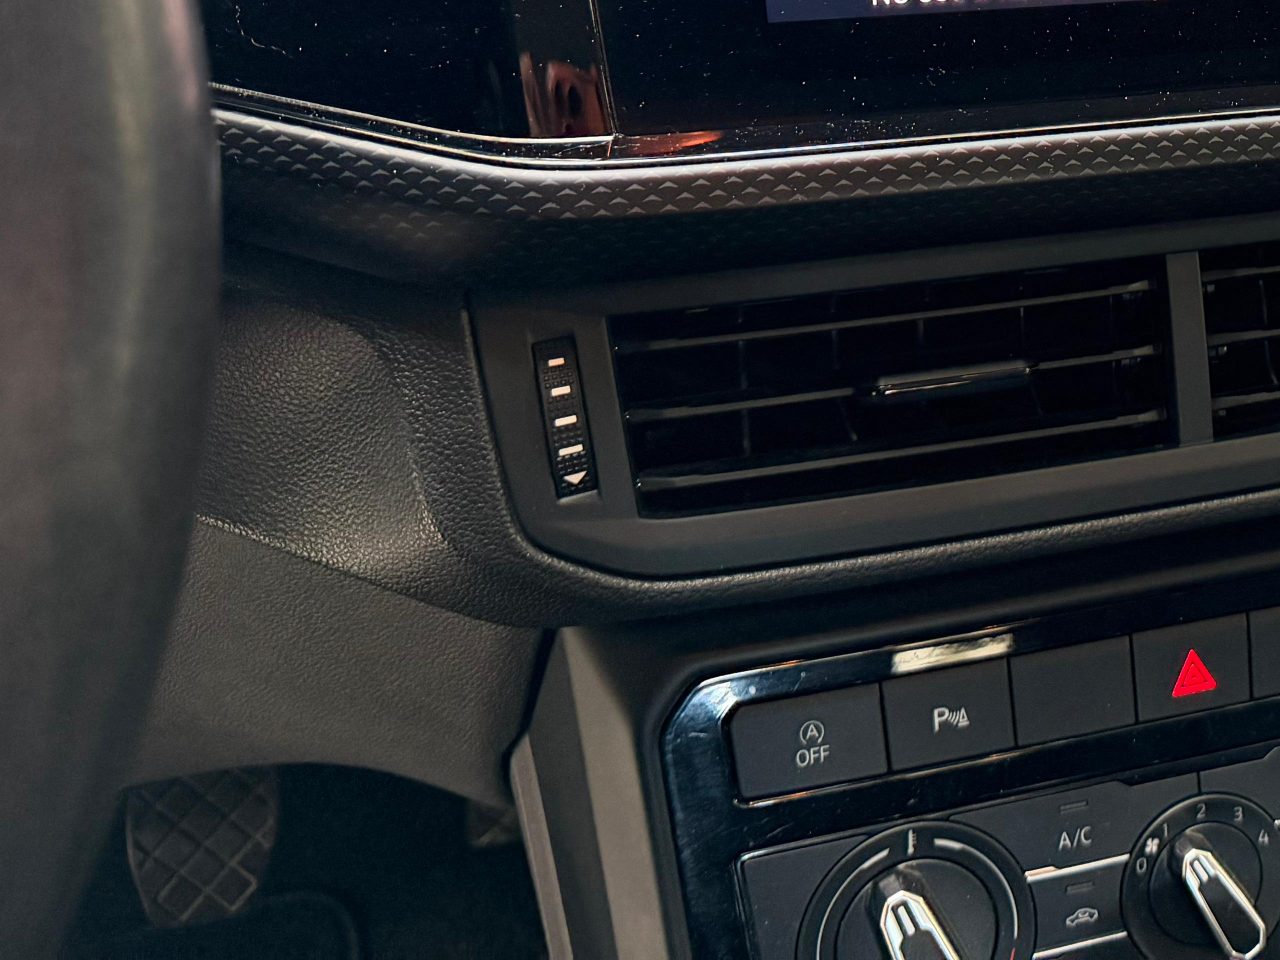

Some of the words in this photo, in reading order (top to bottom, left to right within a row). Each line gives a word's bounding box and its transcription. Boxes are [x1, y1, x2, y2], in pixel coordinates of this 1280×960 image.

[795, 744, 830, 768] OFF
[1196, 803, 1206, 819] 2
[1234, 806, 1243, 822] 3
[1058, 825, 1093, 851] A/C
